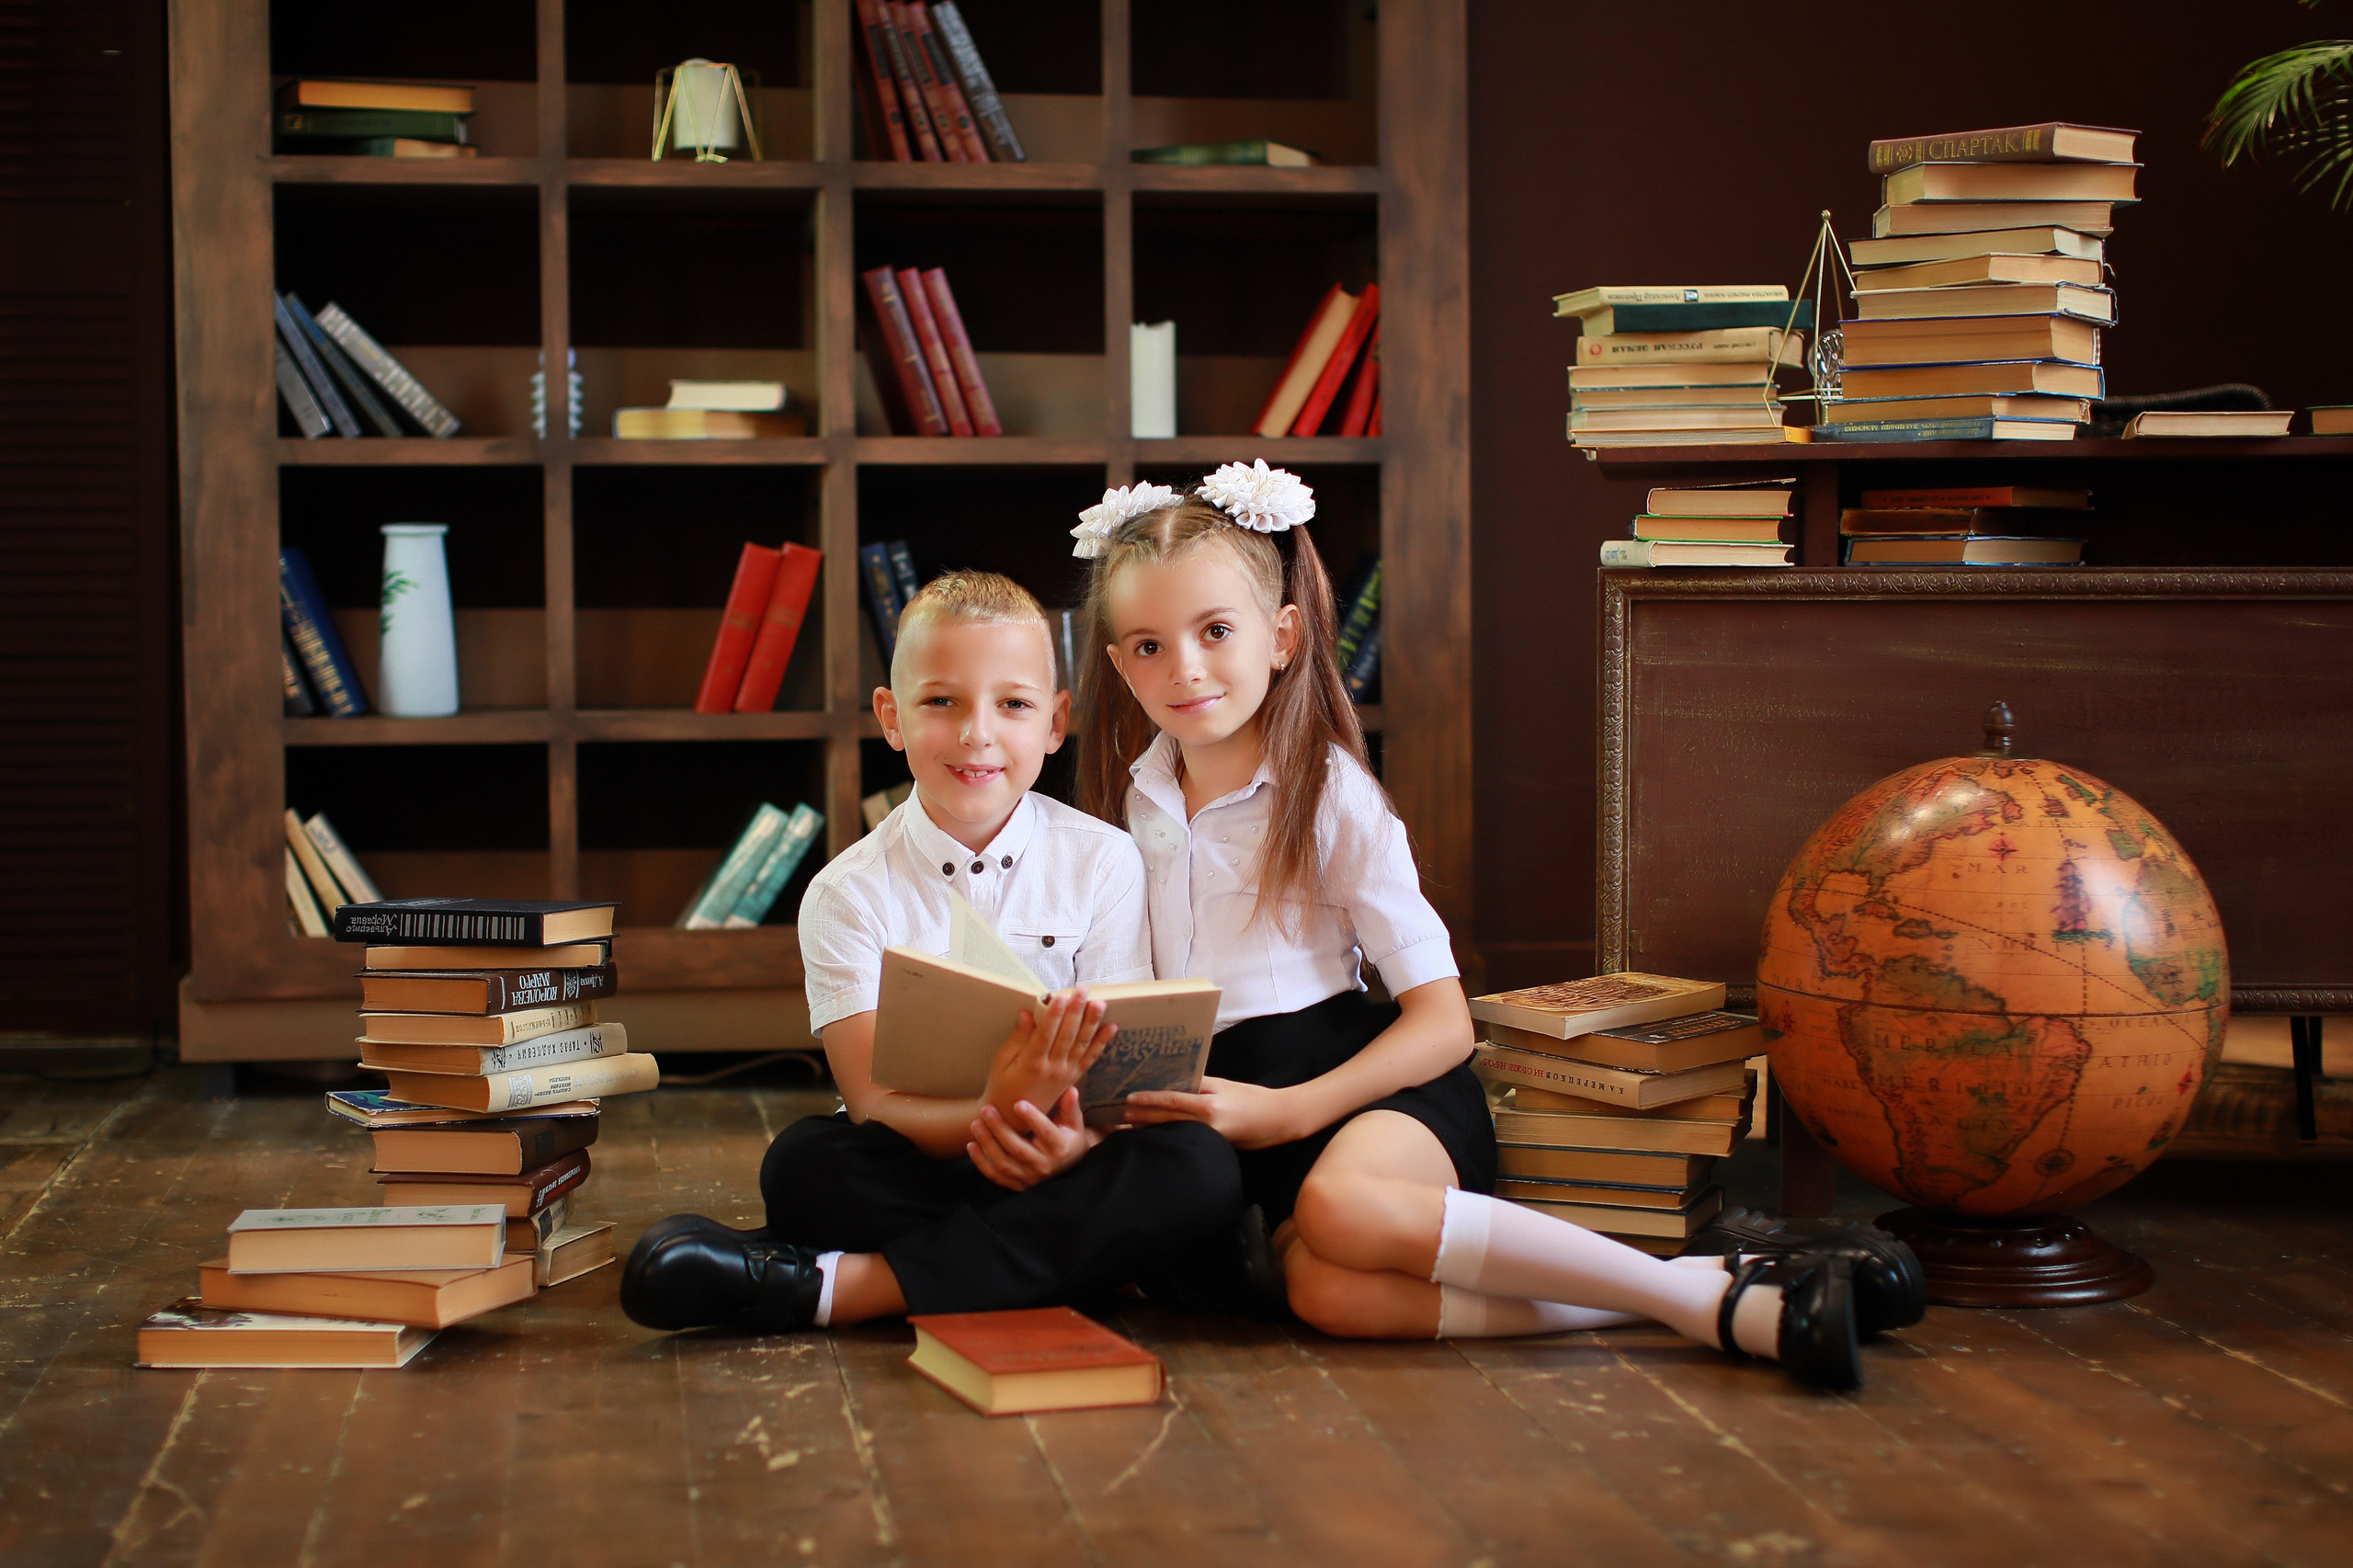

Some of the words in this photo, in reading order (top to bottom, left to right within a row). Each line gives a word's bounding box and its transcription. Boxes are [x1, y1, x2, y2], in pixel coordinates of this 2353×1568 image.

[1928, 132, 2019, 160] СПАРТАК
[1967, 862, 2029, 875] MAR
[350, 912, 399, 926] Моравиа
[518, 971, 551, 989] МАРГО
[511, 985, 559, 1006] КОРОЛЕВА
[1534, 1068, 1544, 1078] НА
[1545, 1071, 1606, 1091] МЕРЕЦКОВ
